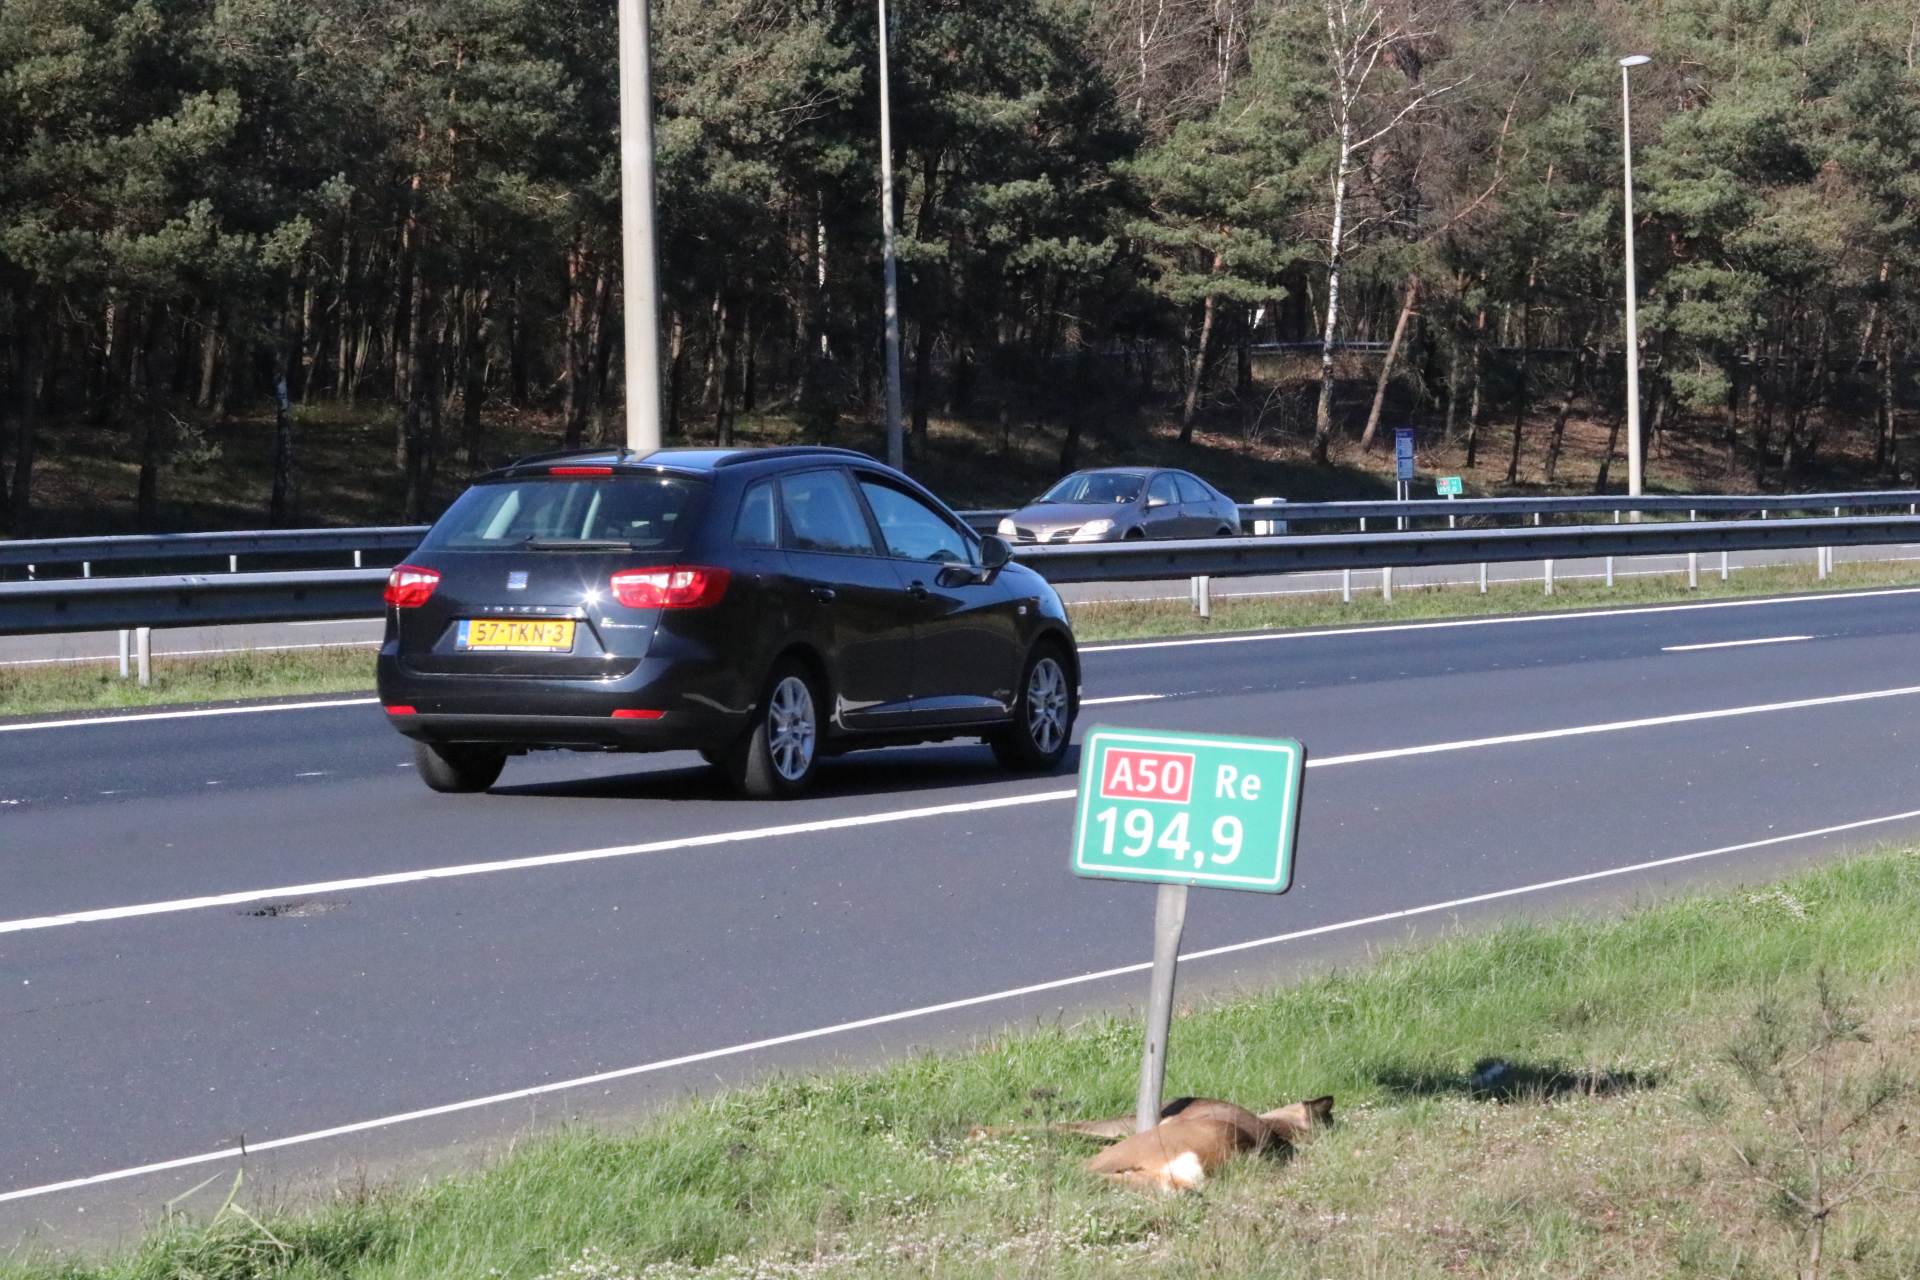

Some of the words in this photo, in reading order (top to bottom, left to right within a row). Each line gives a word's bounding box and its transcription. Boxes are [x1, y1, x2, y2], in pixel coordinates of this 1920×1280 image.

[477, 623, 564, 643] 57-TKN-3
[1109, 757, 1185, 794] A50
[1215, 764, 1261, 801] Re
[1096, 806, 1244, 869] 194,9
